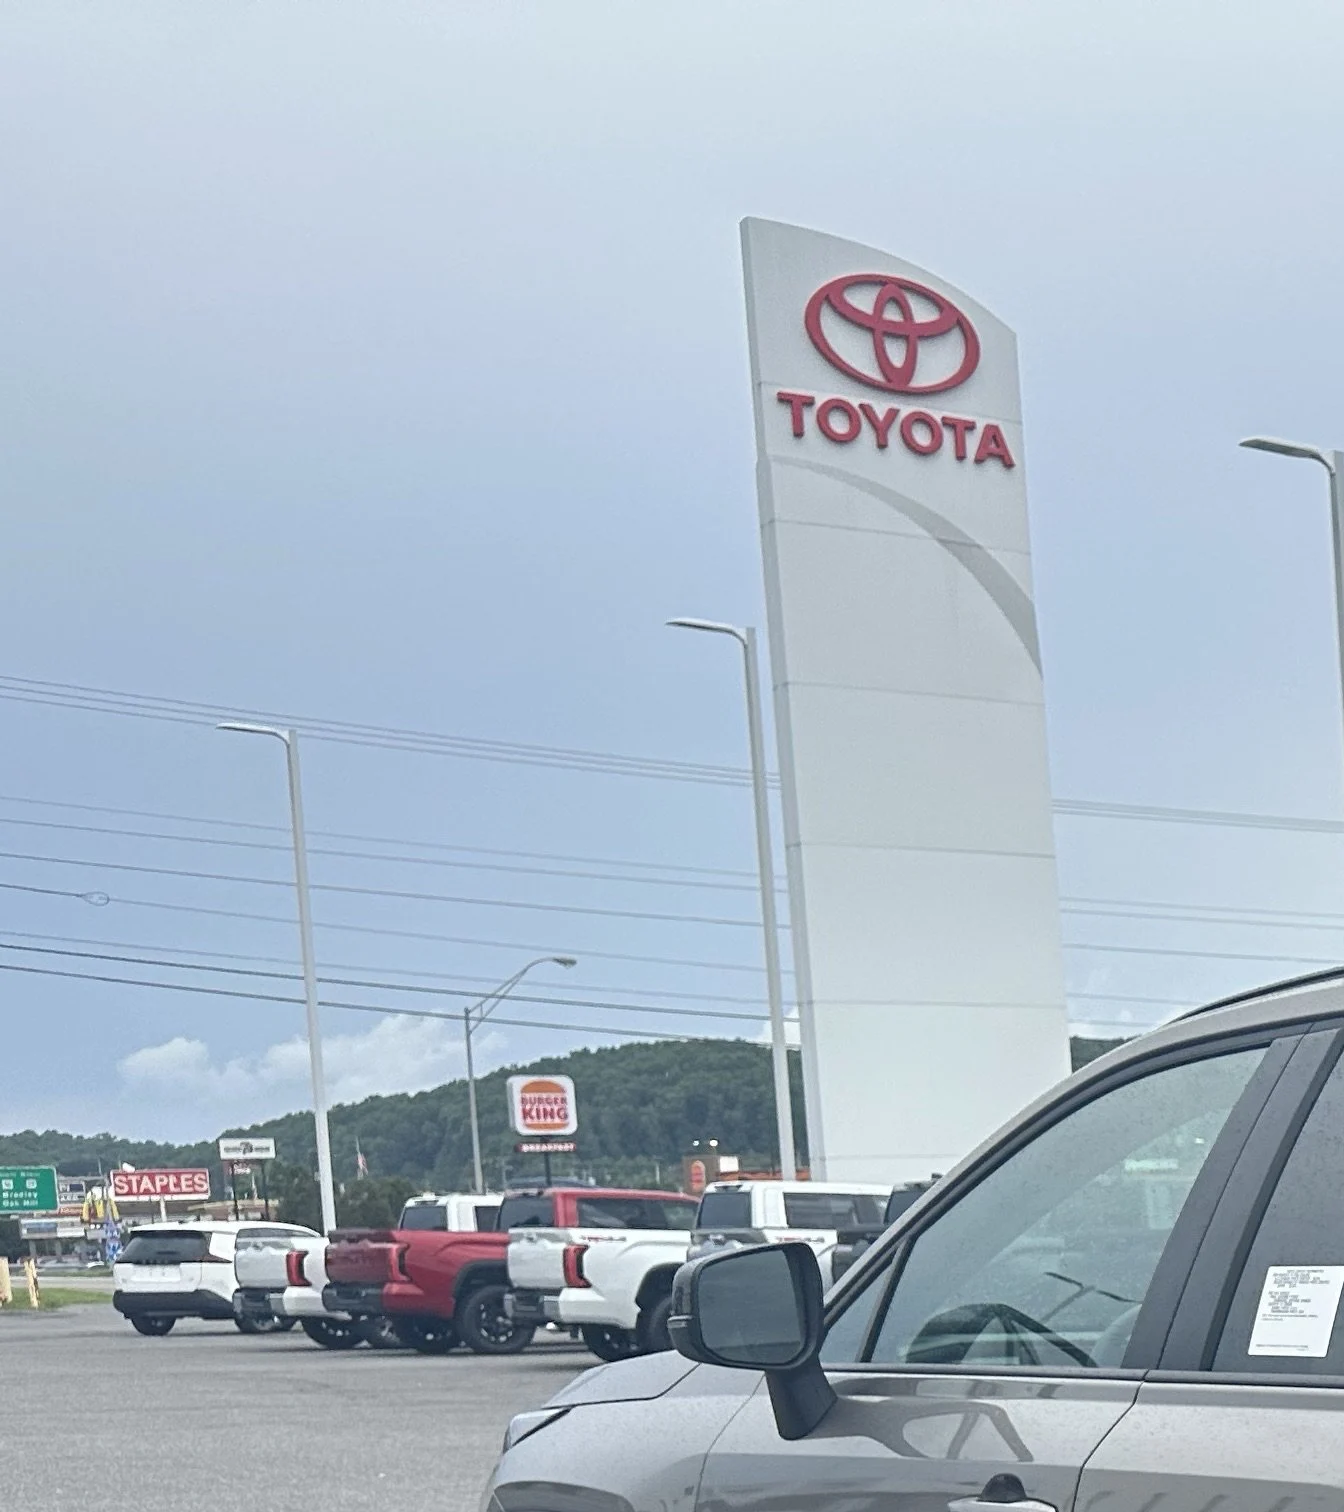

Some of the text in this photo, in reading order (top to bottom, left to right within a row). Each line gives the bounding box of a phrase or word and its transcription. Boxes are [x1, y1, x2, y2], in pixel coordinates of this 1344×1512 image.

[777, 391, 1016, 469] TOYOTA
[521, 1097, 567, 1106] BURGER
[523, 1107, 568, 1120] KING
[115, 1172, 208, 1195] STAPLES
